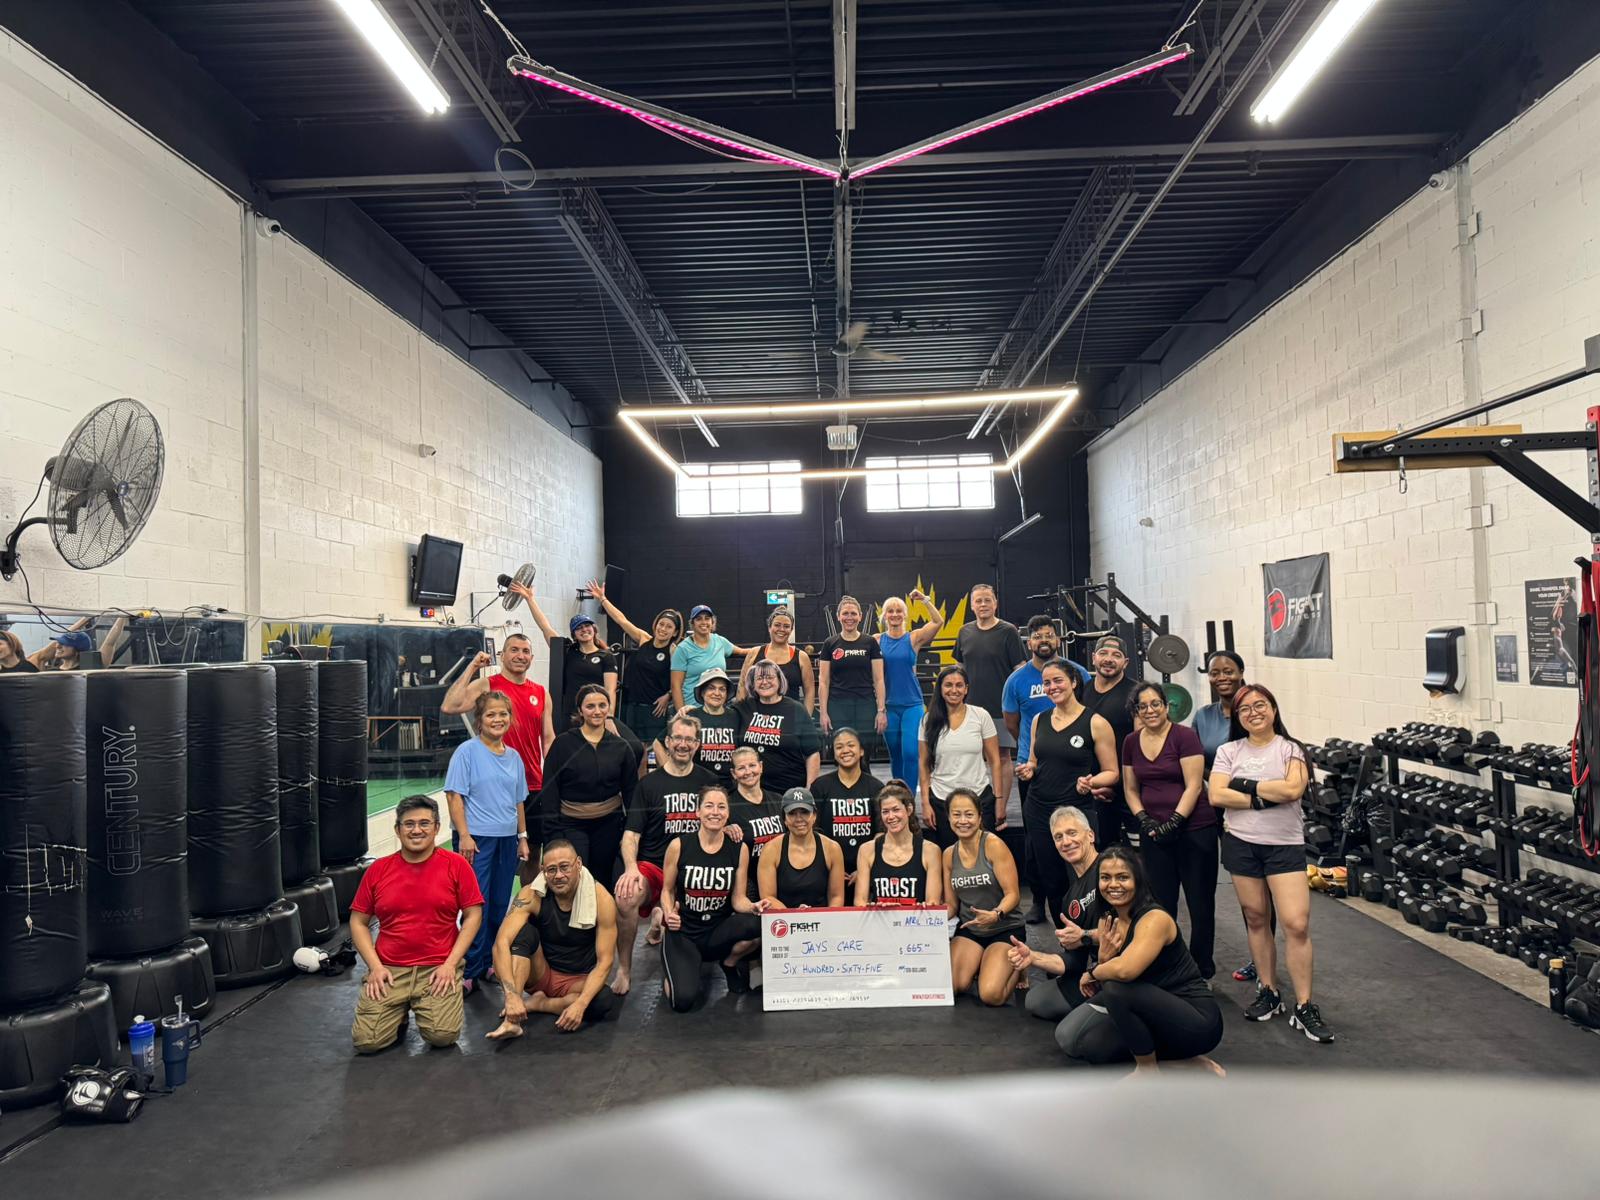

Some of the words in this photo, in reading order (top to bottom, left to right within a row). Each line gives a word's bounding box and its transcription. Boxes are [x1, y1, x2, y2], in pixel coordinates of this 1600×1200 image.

[749, 711, 784, 729] TRUST
[700, 727, 734, 744] TRUST
[743, 731, 780, 746] PROCESS
[664, 792, 700, 813] TRUST
[830, 798, 870, 816] TRUST
[665, 820, 700, 833] PROCESS
[749, 815, 783, 837] TRUST
[832, 823, 871, 837] PROCESS
[684, 865, 734, 890] TRUST
[951, 873, 992, 890] FIGHTER
[874, 877, 917, 898] TRUST
[685, 893, 727, 912] PROCESS
[790, 922, 820, 934] FIGHT
[801, 941, 828, 954] JAYS
[837, 940, 864, 952] CARE
[802, 964, 835, 974] HUNDRED
